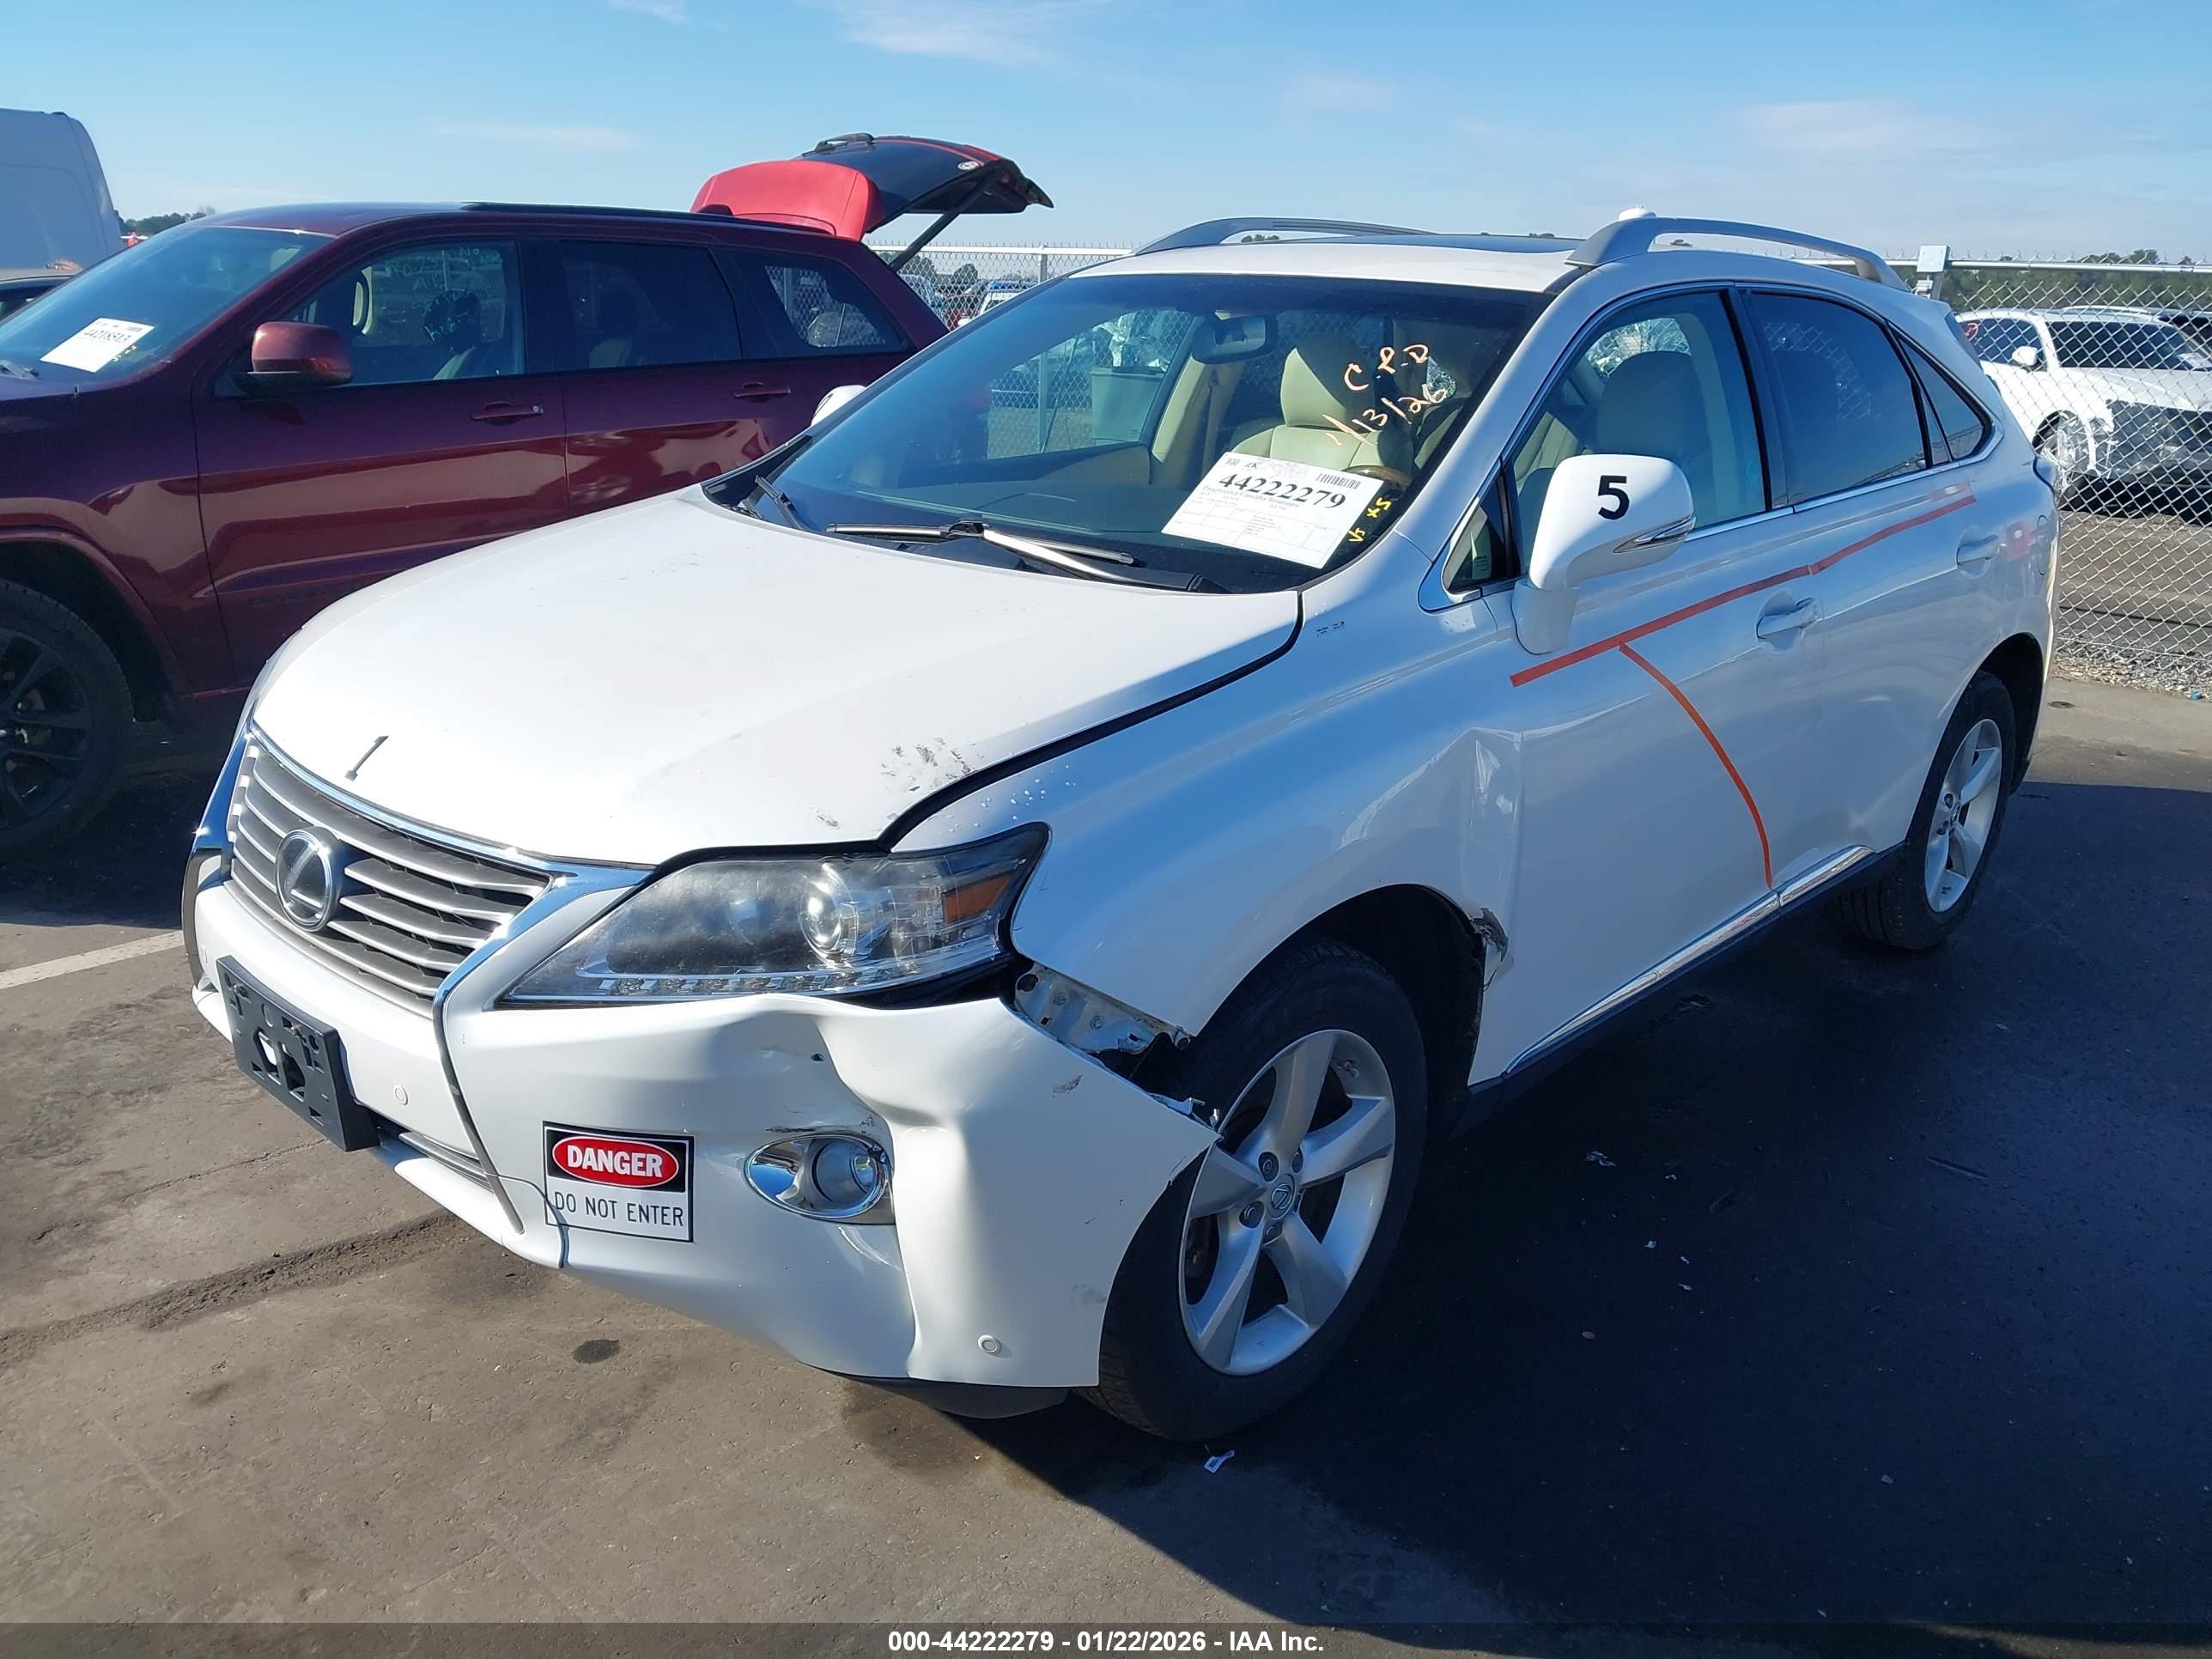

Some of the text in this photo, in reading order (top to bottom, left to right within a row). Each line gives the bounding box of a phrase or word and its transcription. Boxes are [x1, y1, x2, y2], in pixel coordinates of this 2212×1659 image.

[1219, 473, 1346, 509] 44222279
[1597, 475, 1630, 520] 5
[568, 1145, 664, 1177] DANGER
[555, 1192, 684, 1226] DO NOT ENTER
